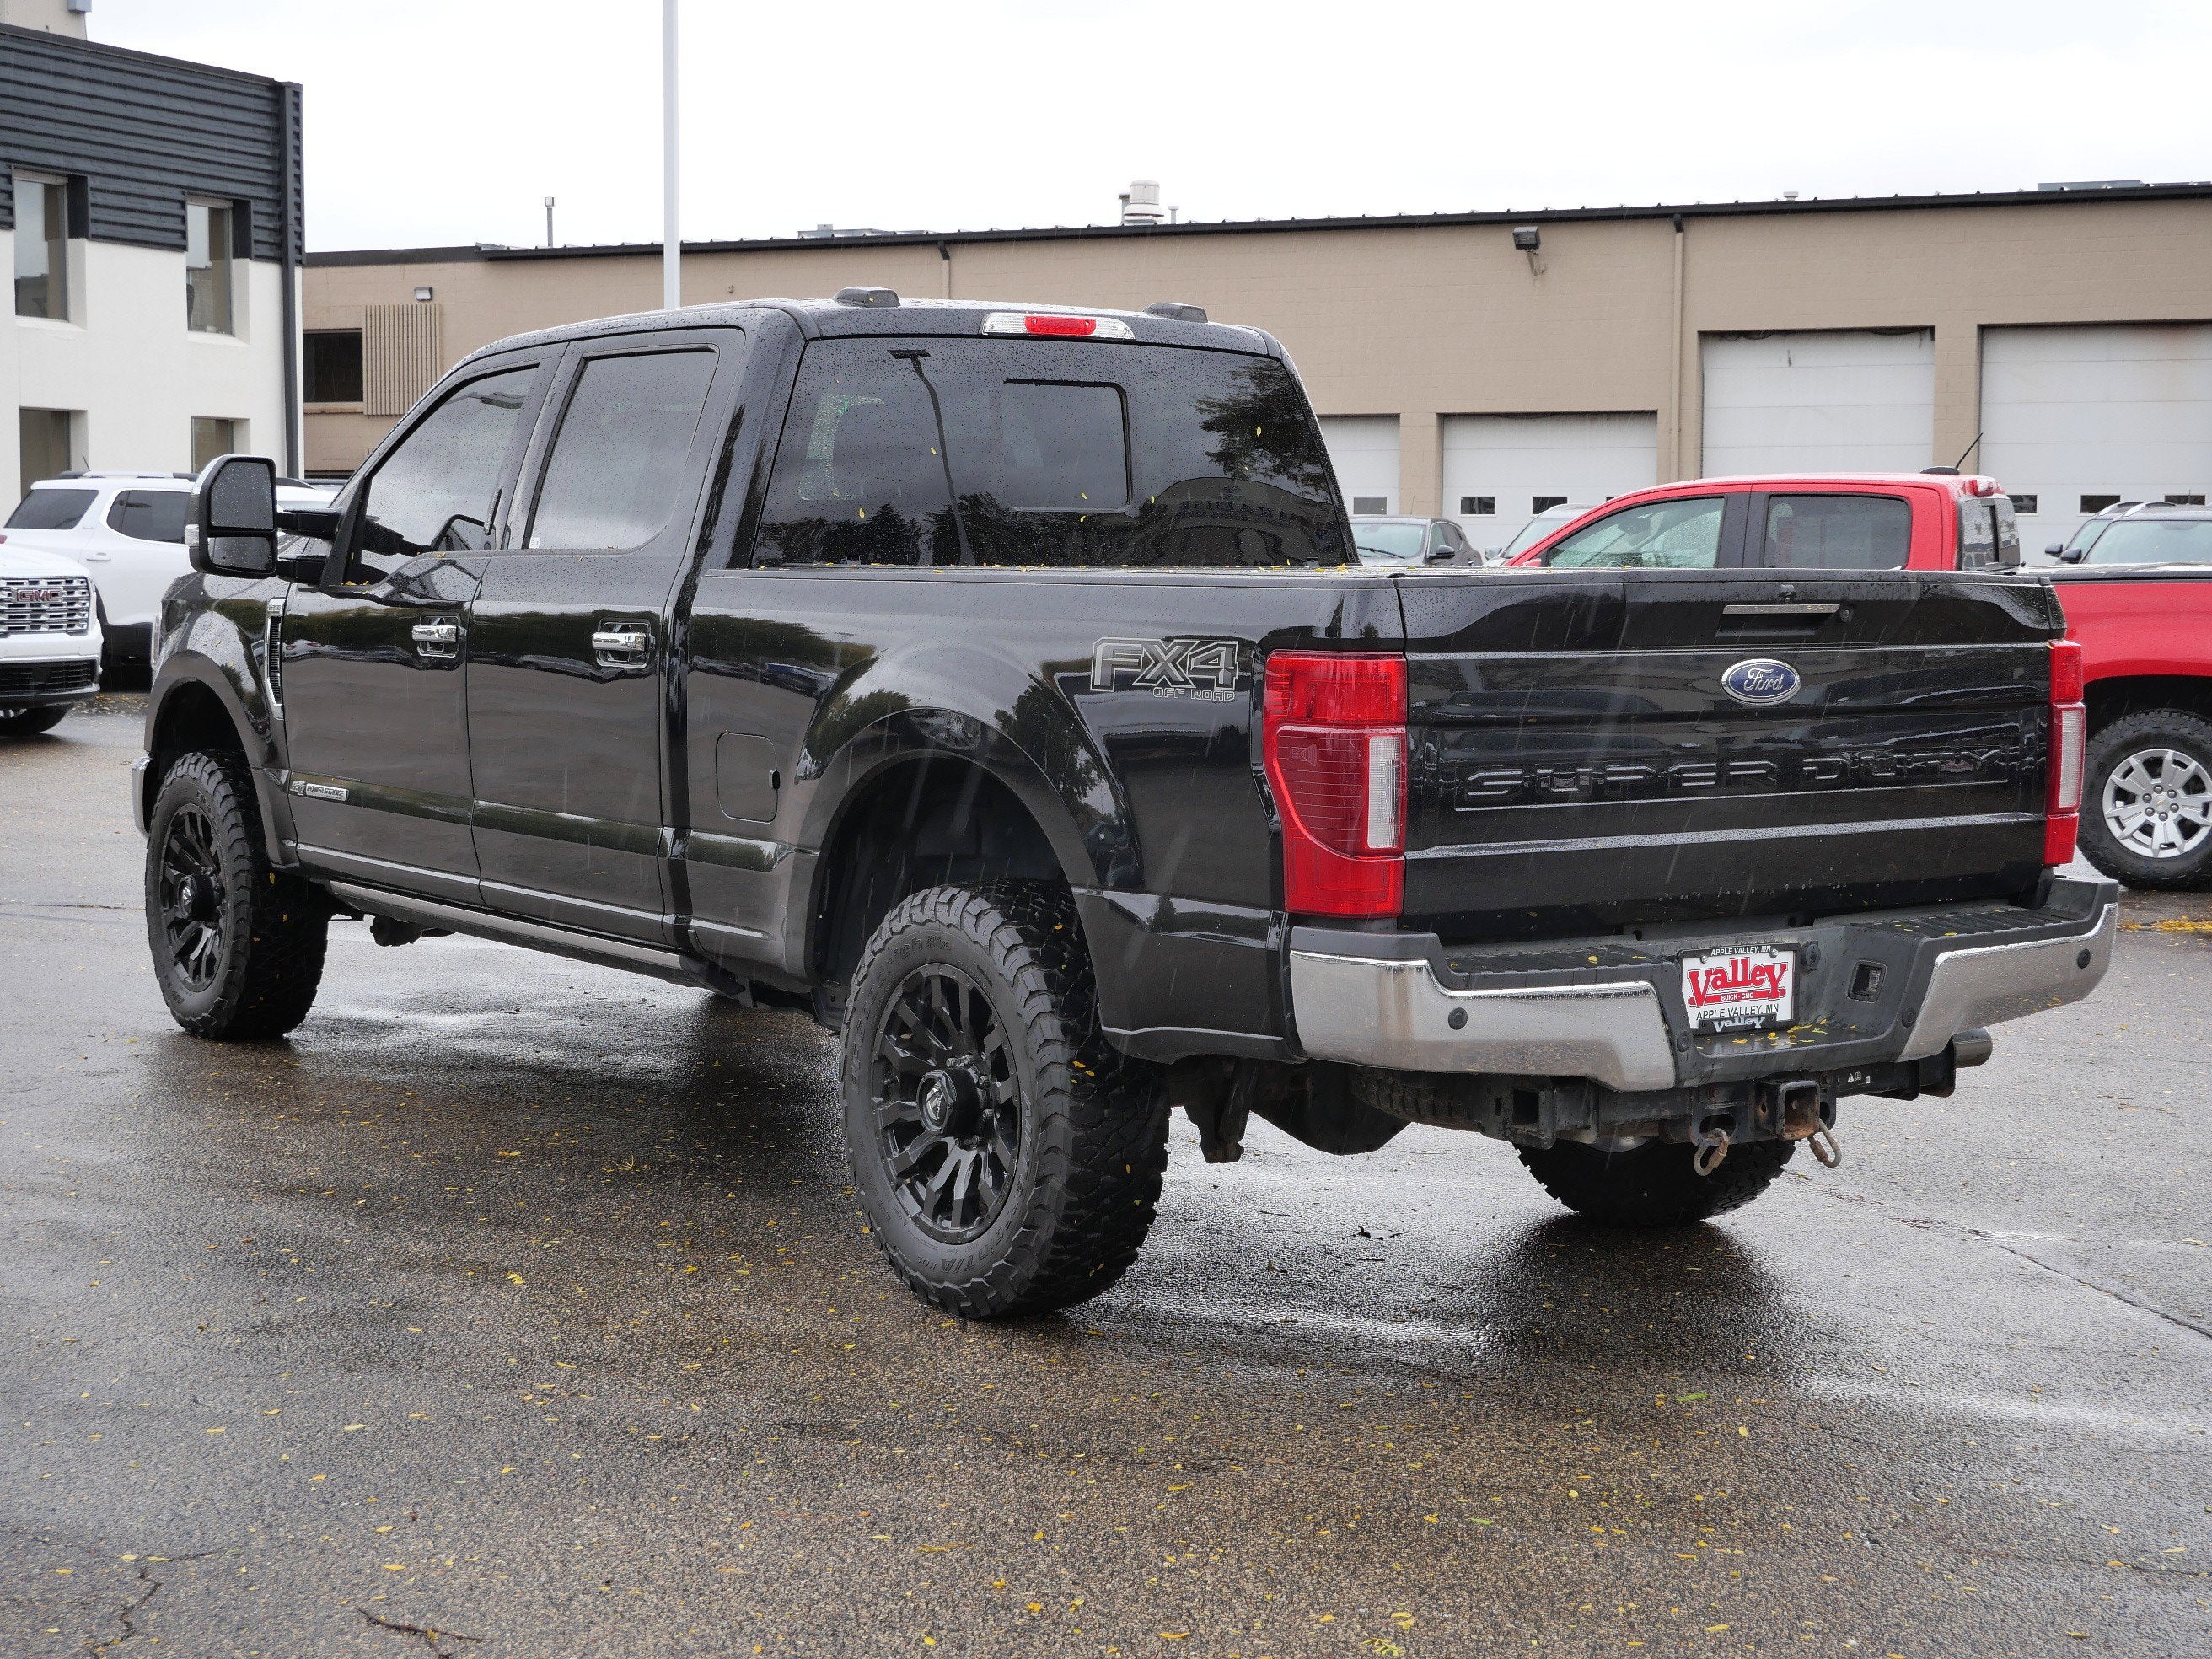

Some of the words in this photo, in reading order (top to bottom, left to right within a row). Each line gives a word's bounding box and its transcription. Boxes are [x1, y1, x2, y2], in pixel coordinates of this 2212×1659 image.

[18, 589, 61, 601] GMC
[1090, 636, 1239, 692] FX4
[1743, 668, 1785, 692] Ford
[1152, 686, 1186, 699] OFF
[1190, 689, 1236, 702] ROAD
[1464, 760, 1779, 803] SUPER
[1802, 750, 2006, 784] DUTY
[1710, 948, 1733, 957] APPLE
[1696, 1008, 1726, 1021] APPLE
[1765, 1003, 1779, 1014] MN
